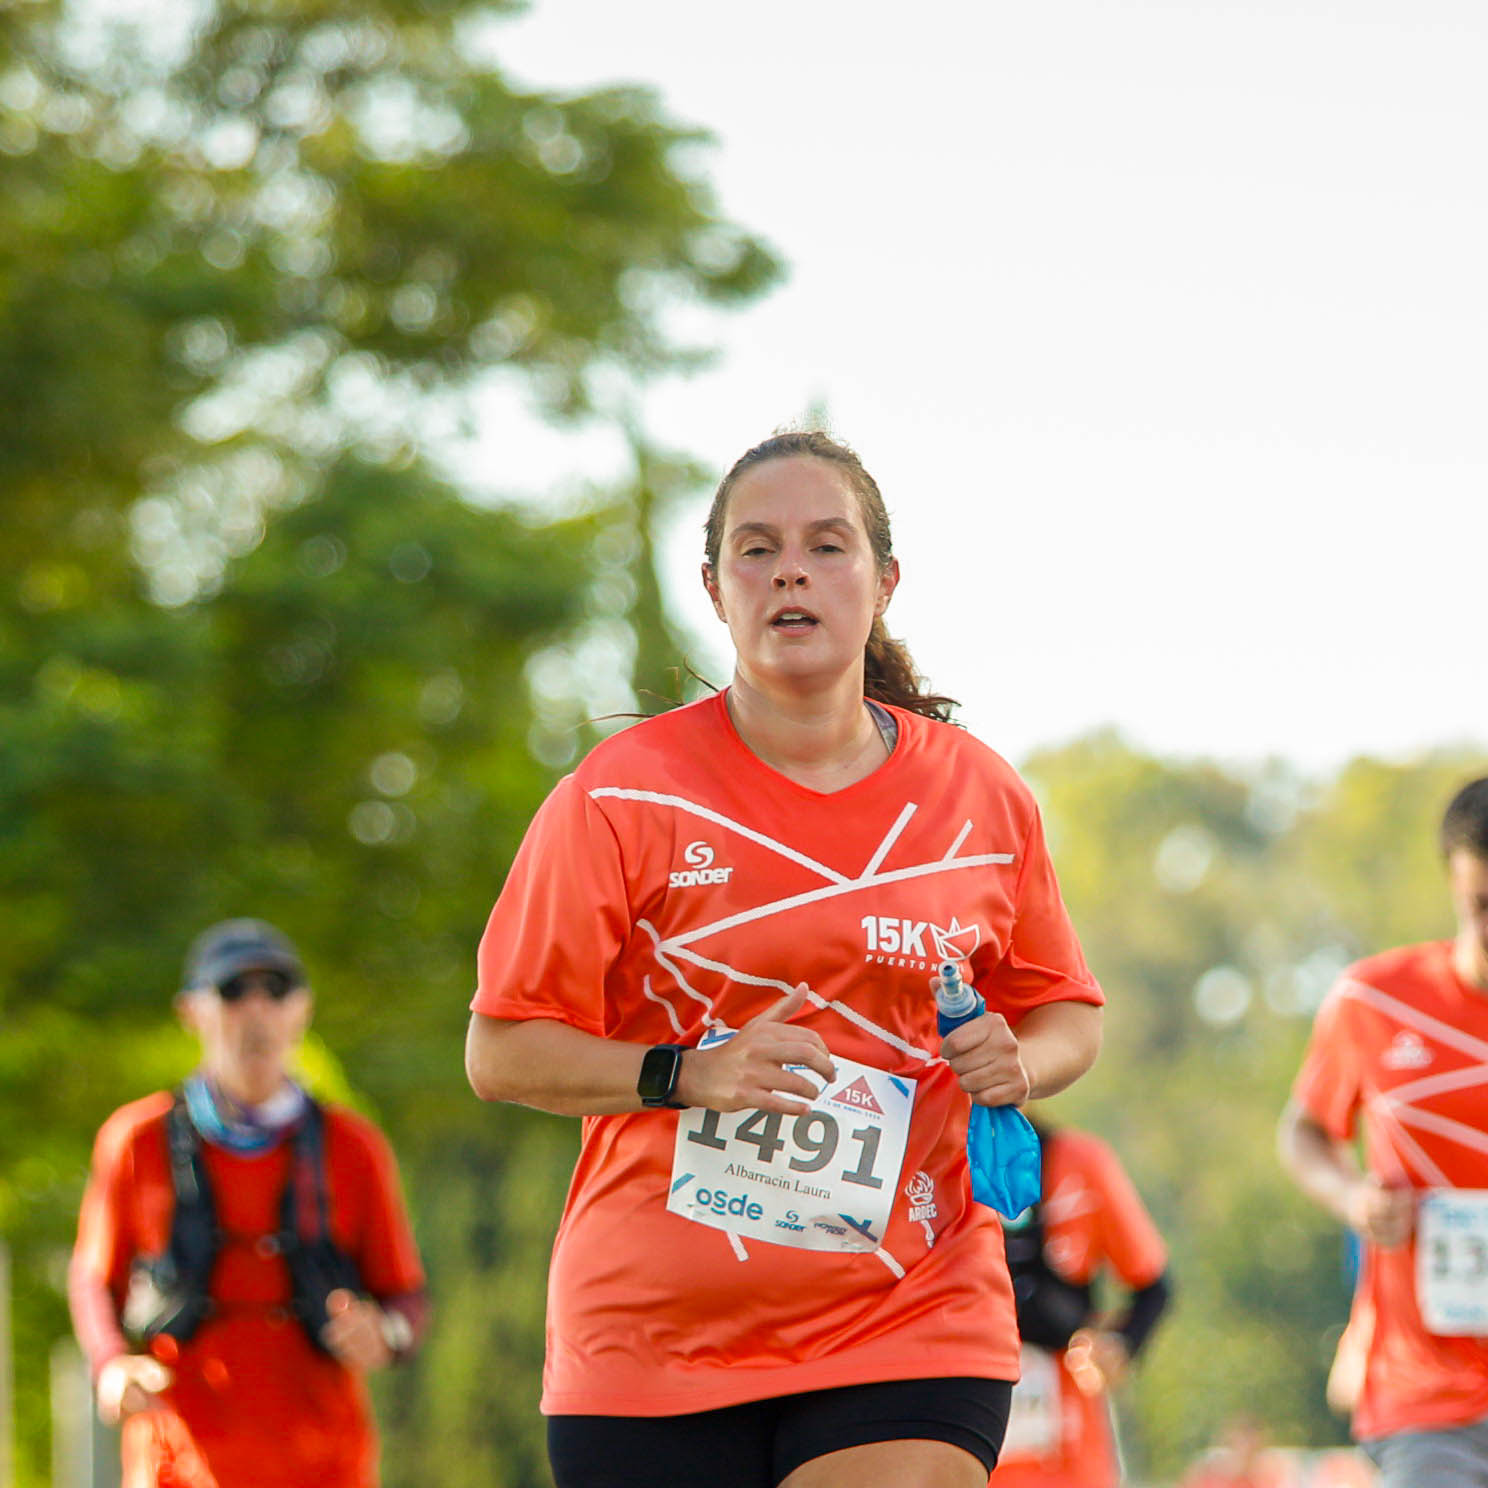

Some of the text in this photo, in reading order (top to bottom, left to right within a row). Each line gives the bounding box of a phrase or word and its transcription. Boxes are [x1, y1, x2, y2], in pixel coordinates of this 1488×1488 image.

[860, 915, 929, 958] 15K
[865, 954, 926, 971] PUERTO
[845, 1088, 873, 1107] 15K
[687, 1107, 884, 1190] 1491
[724, 1162, 832, 1201] Albarracin Laura
[696, 1187, 764, 1221] osde
